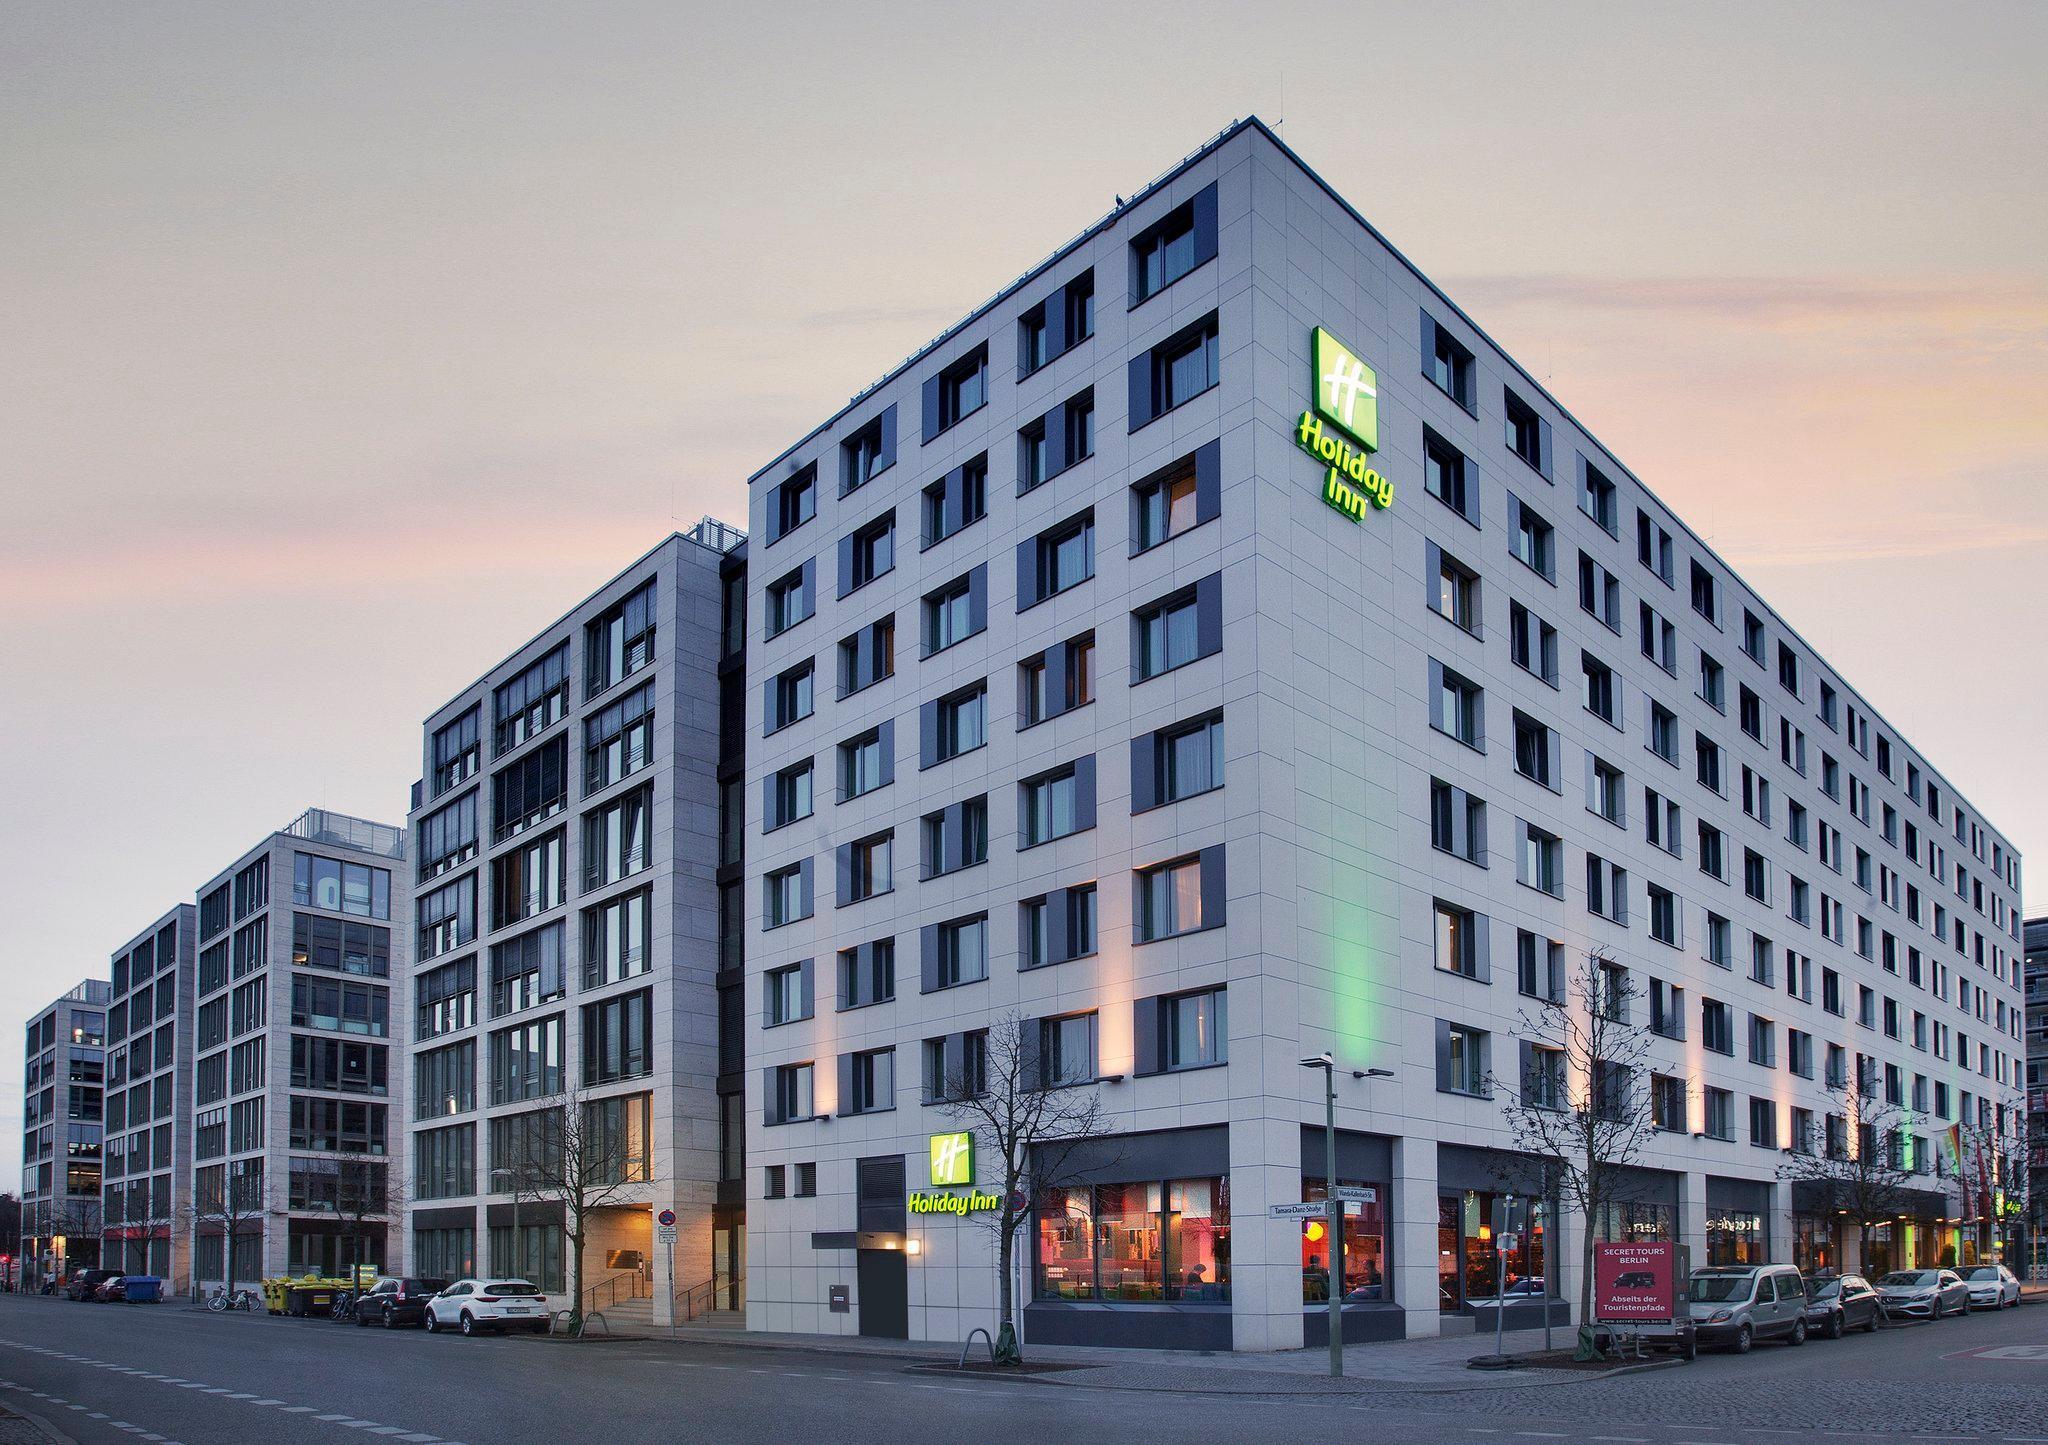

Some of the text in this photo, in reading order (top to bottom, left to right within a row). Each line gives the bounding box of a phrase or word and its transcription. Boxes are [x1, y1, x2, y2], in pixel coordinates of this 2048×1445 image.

[1298, 410, 1395, 510] Holiday
[1327, 466, 1367, 522] Inn
[908, 1189, 998, 1216] Holiday Inn
[1604, 1248, 1635, 1256] SECRET
[1603, 1304, 1666, 1312] Touristenpfade
